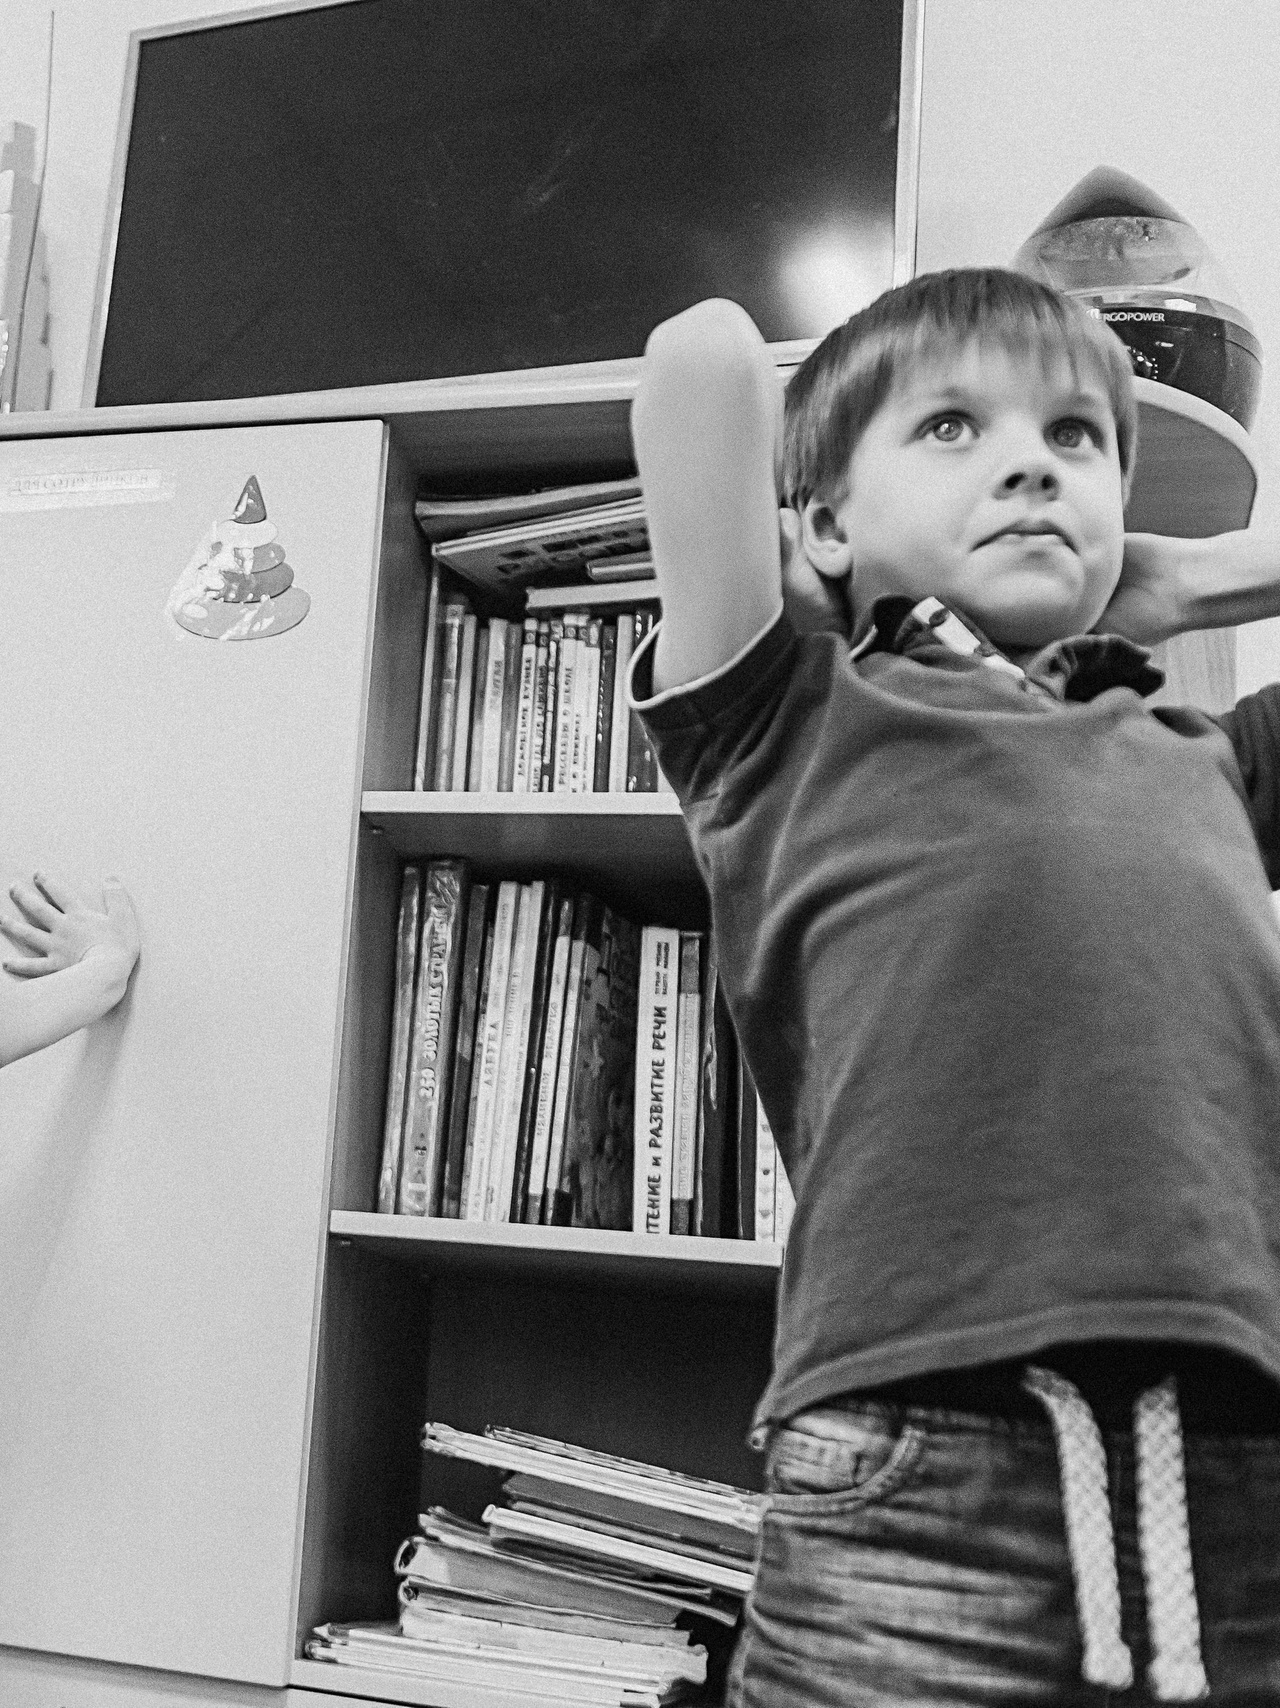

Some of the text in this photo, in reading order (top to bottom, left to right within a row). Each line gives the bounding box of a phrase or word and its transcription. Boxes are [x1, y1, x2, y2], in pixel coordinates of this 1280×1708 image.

[1100, 311, 1165, 322] RGOPOWER
[422, 985, 443, 1063] ЗОЛОТЫХ
[653, 1005, 667, 1051] РЕЧИ
[419, 1067, 436, 1098] 250
[649, 1060, 665, 1149] РАЗВИТИЕ
